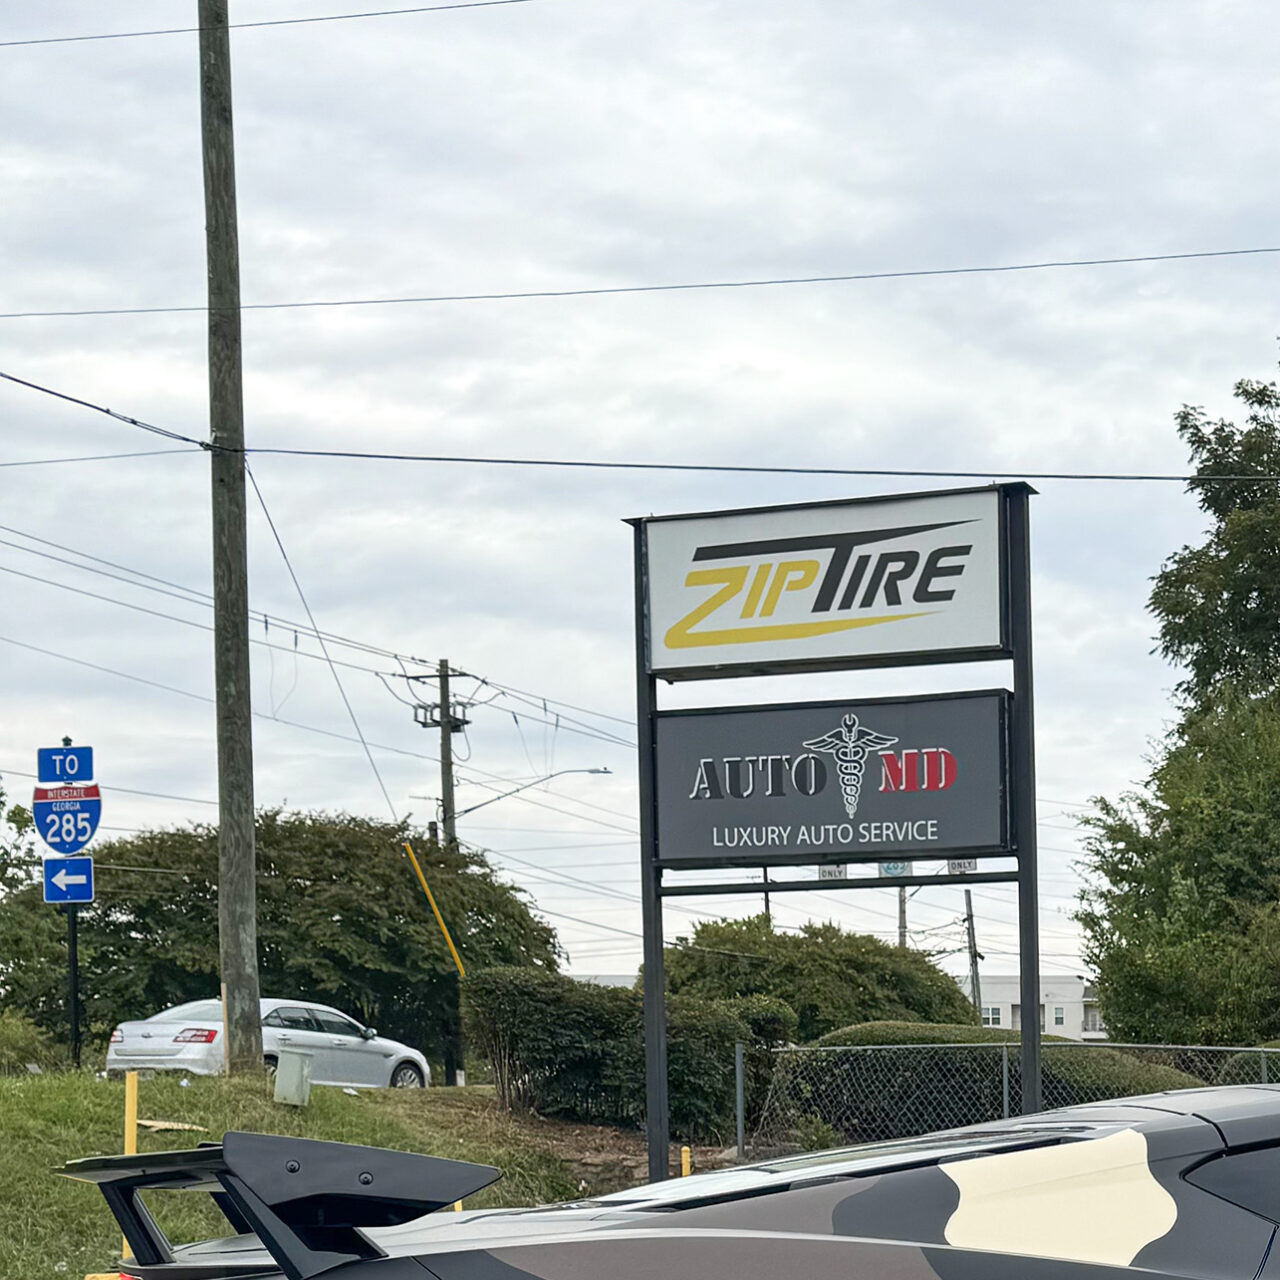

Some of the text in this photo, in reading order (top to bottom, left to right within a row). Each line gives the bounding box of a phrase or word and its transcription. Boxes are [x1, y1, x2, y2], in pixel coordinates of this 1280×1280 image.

[51, 755, 79, 775] TO
[689, 748, 958, 800] AUTO MD
[47, 789, 86, 799] INTERSTATE
[52, 801, 81, 812] GEORGIA
[46, 813, 91, 843] 285
[713, 820, 938, 847] LUXURY AUTO SERVICE
[951, 861, 973, 870] ONLY
[822, 870, 843, 878] ONLY
